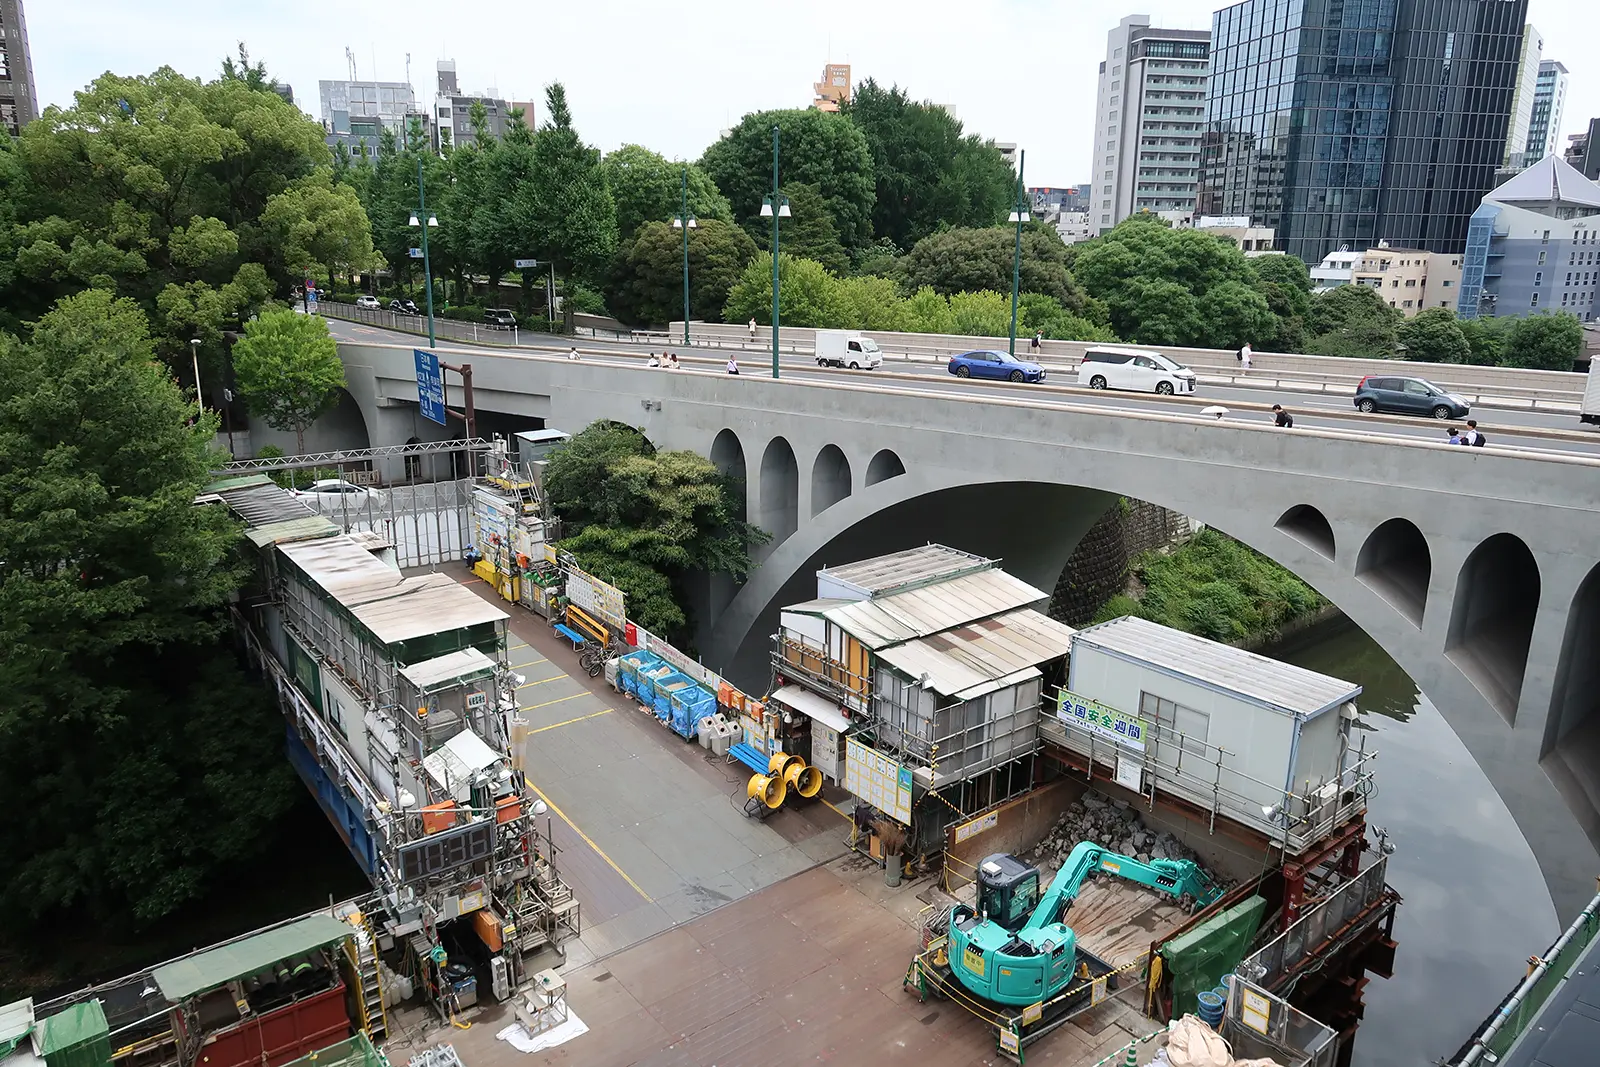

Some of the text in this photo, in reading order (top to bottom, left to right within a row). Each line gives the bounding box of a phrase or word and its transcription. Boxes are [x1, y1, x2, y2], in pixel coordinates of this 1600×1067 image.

[1062, 700, 1141, 739] 全国安全週間
